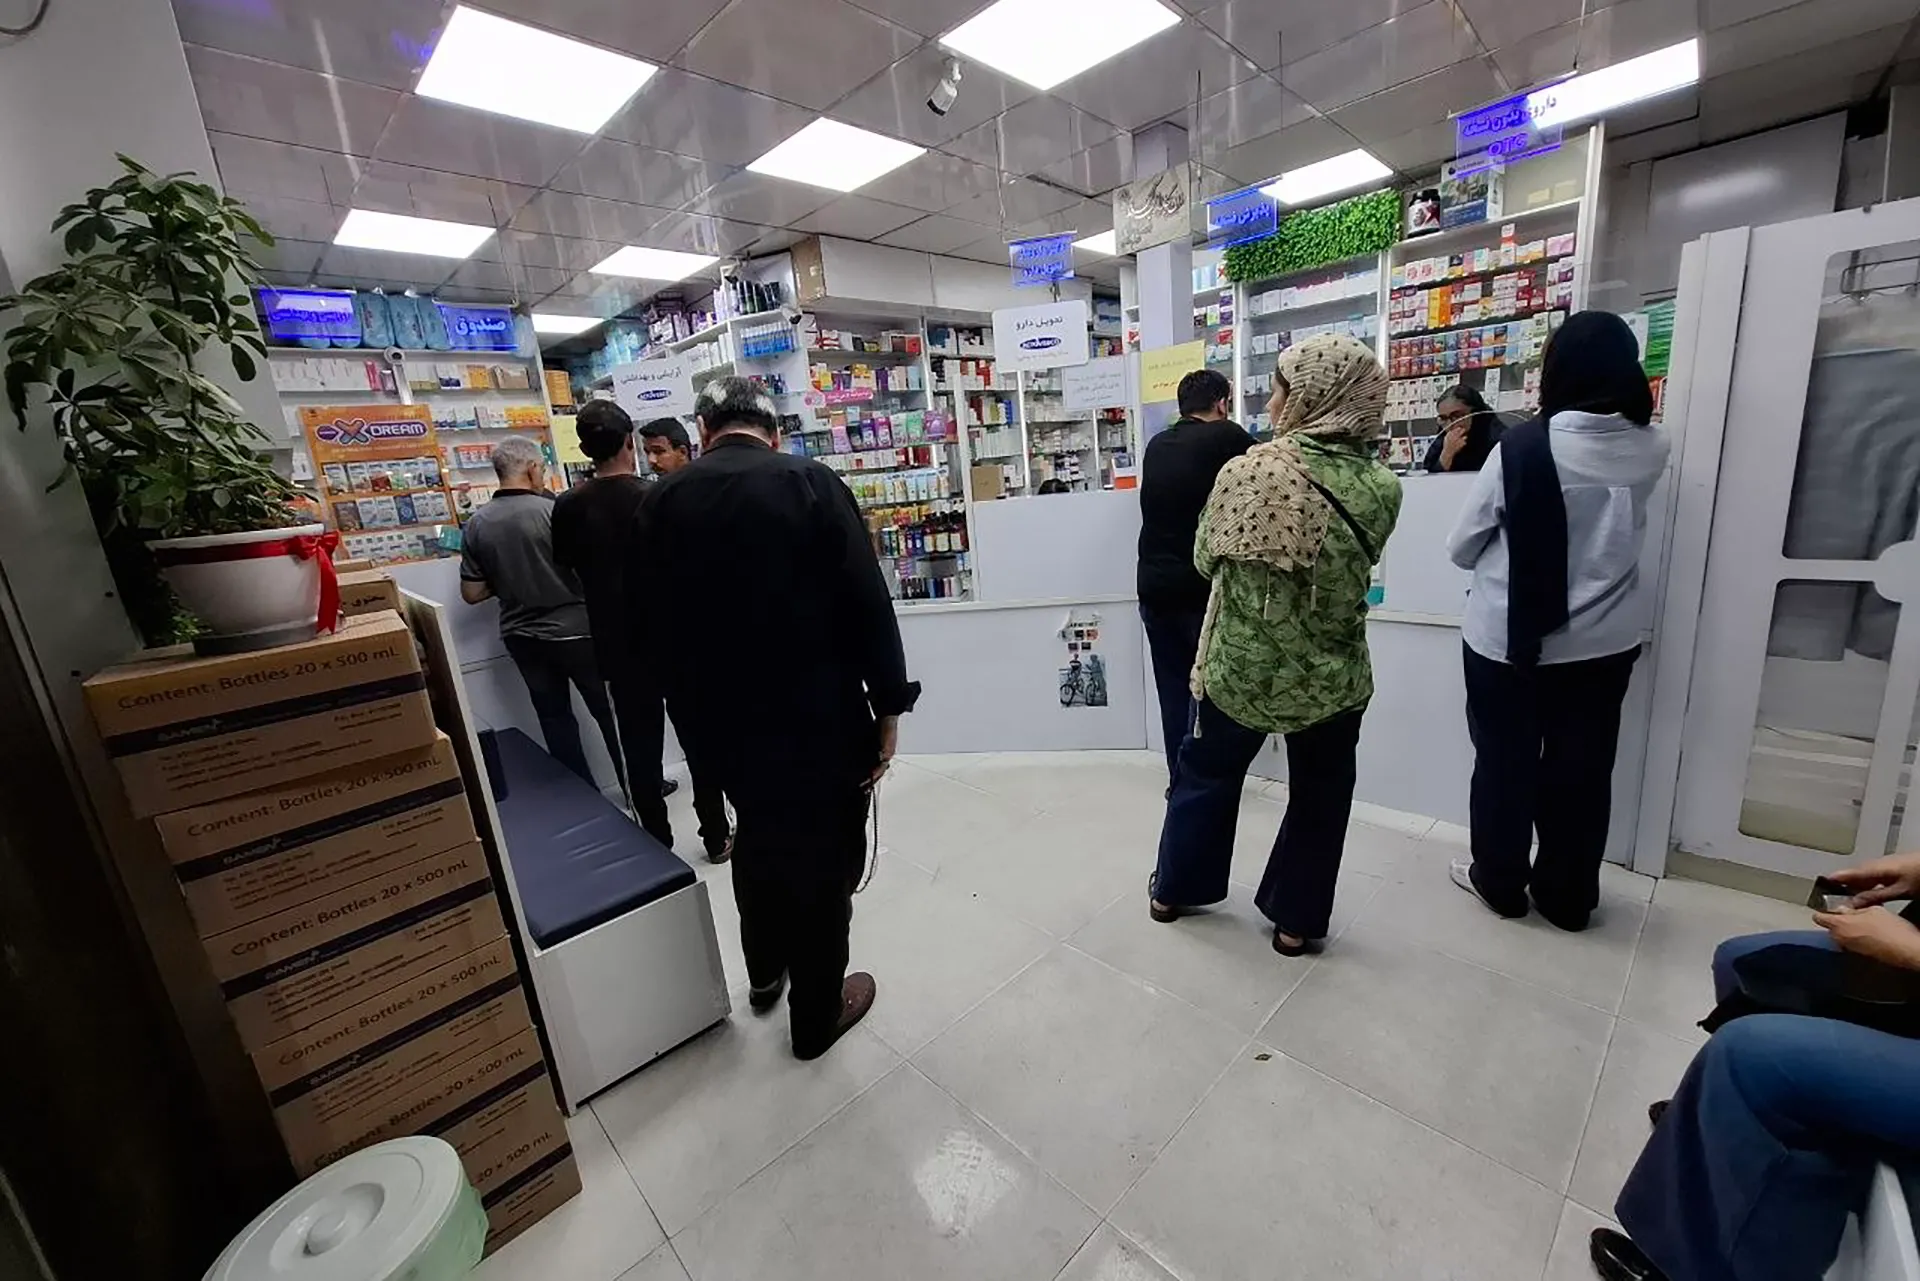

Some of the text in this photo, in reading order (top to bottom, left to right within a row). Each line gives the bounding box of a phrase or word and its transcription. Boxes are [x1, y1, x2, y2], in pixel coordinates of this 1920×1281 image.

[1463, 118, 1491, 136] نسخه
[1491, 108, 1523, 131] بدون
[1488, 133, 1528, 156] OTC
[1215, 202, 1272, 227] پذیرش نسخه
[455, 315, 507, 336] صندوق
[1016, 315, 1063, 331] تحویل دارو
[620, 372, 650, 385] بهداشتی
[657, 366, 682, 380] آرایشی
[369, 423, 425, 436] DREAM
[118, 648, 400, 711] Content: Bottles 20 x 500 mL
[187, 757, 443, 837] Content: Bottles 20 x 500 mL
[231, 858, 469, 957] Content: Bottles 20 x 500 mL
[358, 996, 415, 1029] Bottles
[417, 985, 436, 1002] 20
[439, 981, 449, 991] x
[451, 966, 477, 985] 500
[480, 955, 501, 971] mL
[388, 1093, 443, 1127] Bottles
[445, 1079, 464, 1097] 20
[477, 1058, 504, 1078] 500
[505, 1047, 526, 1065] mL
[506, 1143, 531, 1162] 500
[533, 1131, 552, 1148] mL
